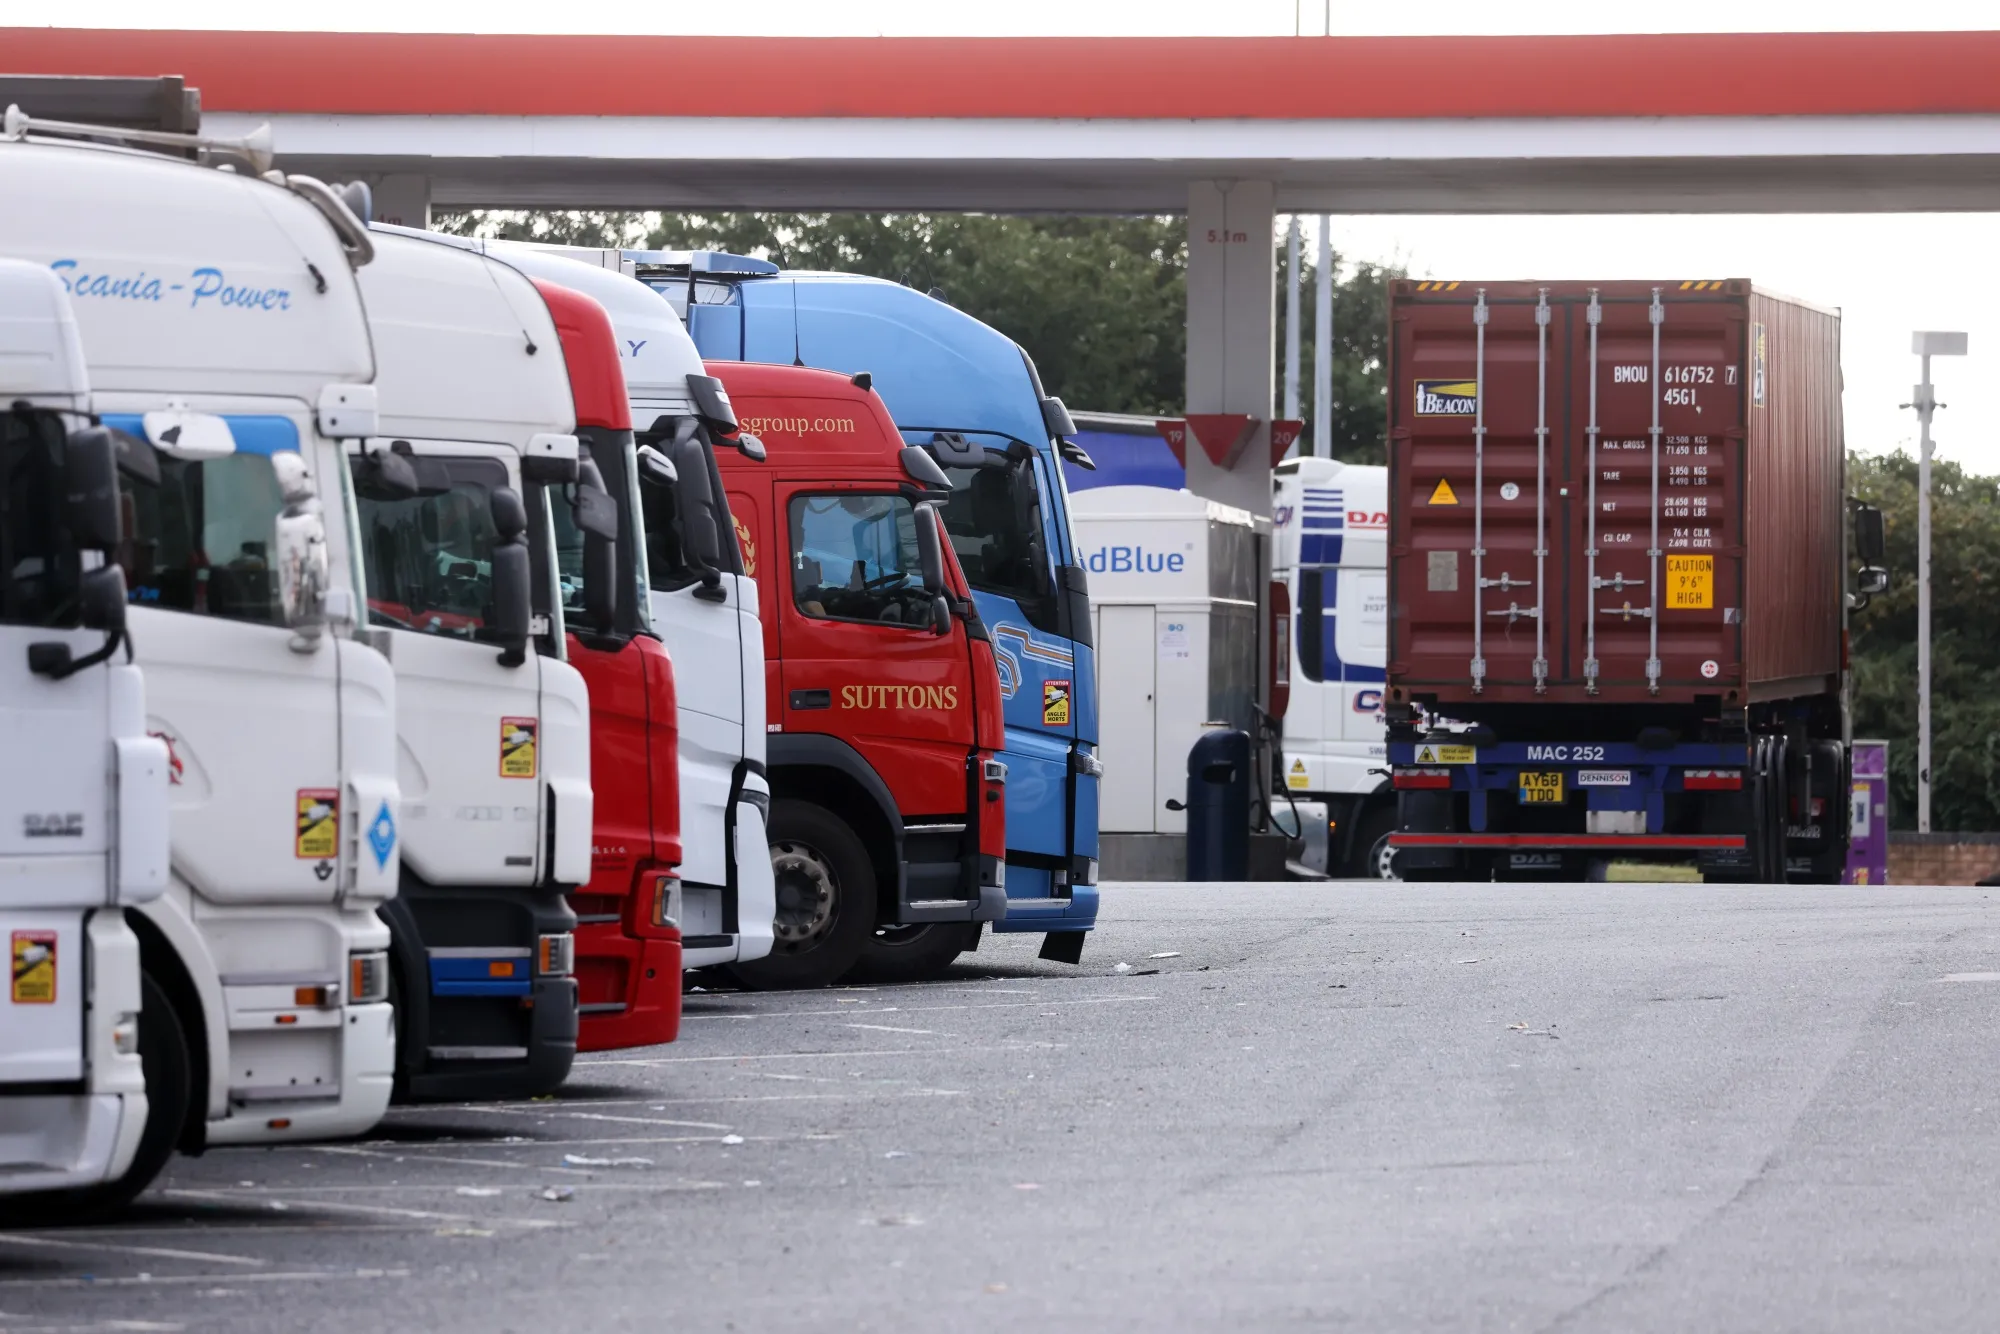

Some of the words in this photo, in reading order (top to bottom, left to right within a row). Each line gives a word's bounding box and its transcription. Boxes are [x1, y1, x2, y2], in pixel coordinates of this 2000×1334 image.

[1613, 365, 1648, 383] BMOU
[1664, 366, 1715, 384] 616752
[1726, 367, 1735, 384] 7
[1424, 393, 1476, 413] BEACON
[1663, 388, 1696, 405] 45G1
[738, 417, 856, 438] sgroup.com
[1168, 430, 1183, 444] 19
[1273, 431, 1292, 444] 20
[1622, 440, 1646, 450] GROSS
[1694, 446, 1708, 455] LBS
[1602, 471, 1620, 480] TARE
[1693, 466, 1708, 475] KGS
[1602, 502, 1616, 511] NET
[1693, 508, 1707, 517] LBS
[1667, 559, 1713, 573] CAUTION
[1676, 592, 1703, 605] HIGH
[841, 685, 958, 709] SUTTONS
[1527, 746, 1568, 761] MAC
[1572, 746, 1604, 761] 252
[1523, 774, 1559, 787] AY68
[1580, 774, 1629, 783] DENNISON
[1528, 788, 1554, 801] TDO
